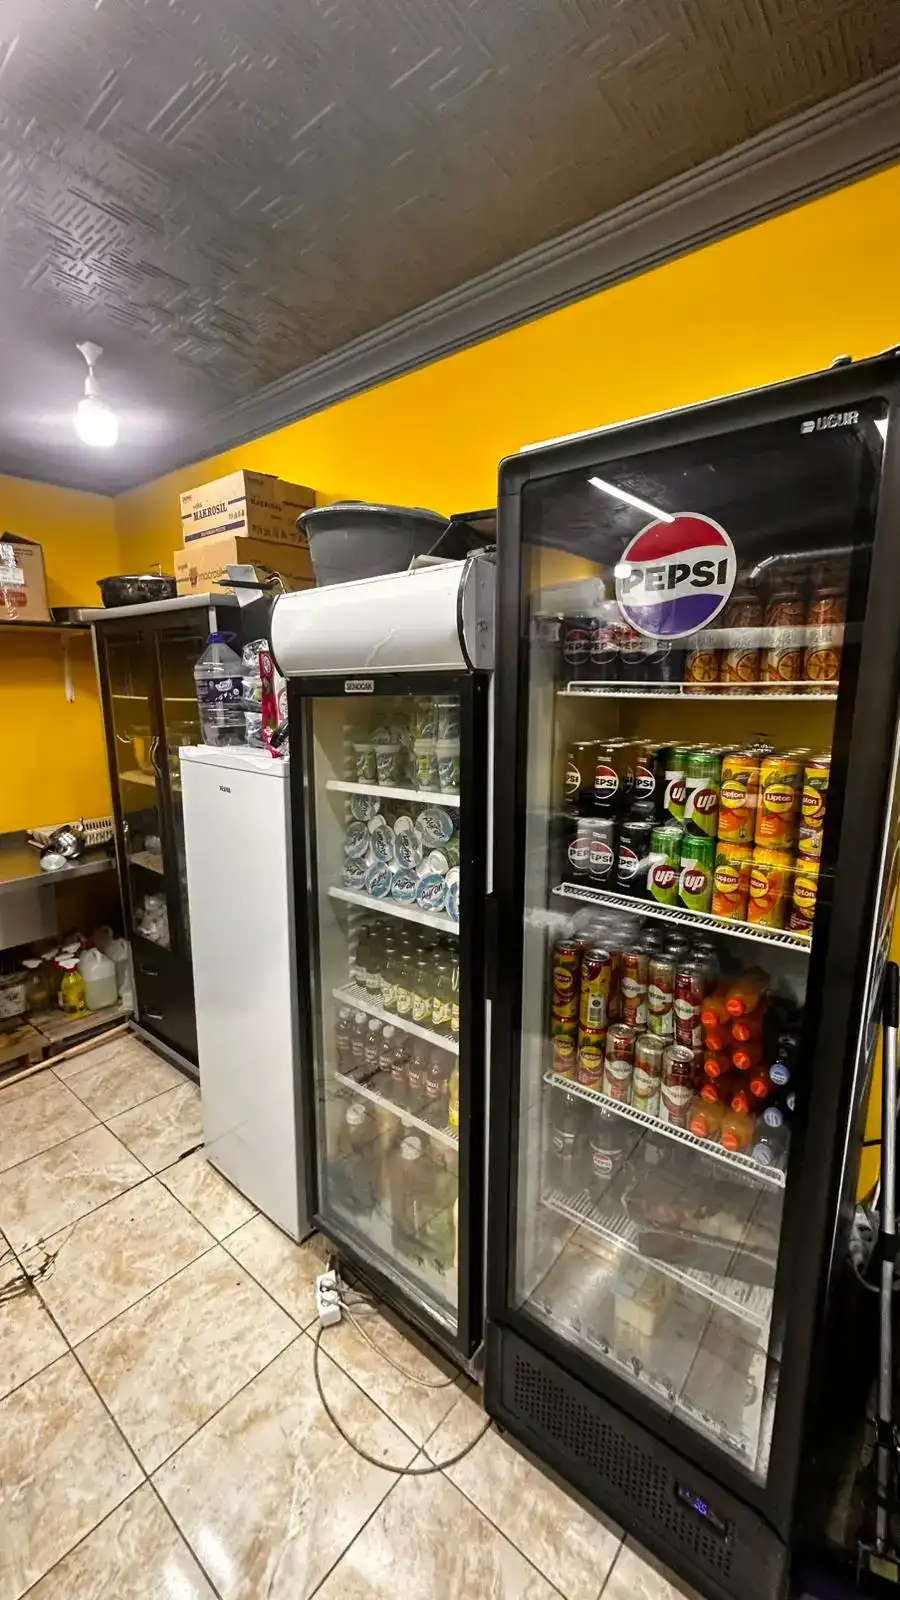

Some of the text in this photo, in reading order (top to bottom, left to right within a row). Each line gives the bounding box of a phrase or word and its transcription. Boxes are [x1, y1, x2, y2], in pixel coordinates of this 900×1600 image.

[622, 558, 728, 594] PEPSI
[595, 777, 617, 788] EPSI
[636, 779, 653, 788] PSI
[767, 793, 792, 801] Lipton
[423, 817, 445, 839] Ayran
[591, 852, 613, 864] EPSI
[394, 879, 416, 890] Ayran
[421, 883, 443, 900] Ayran
